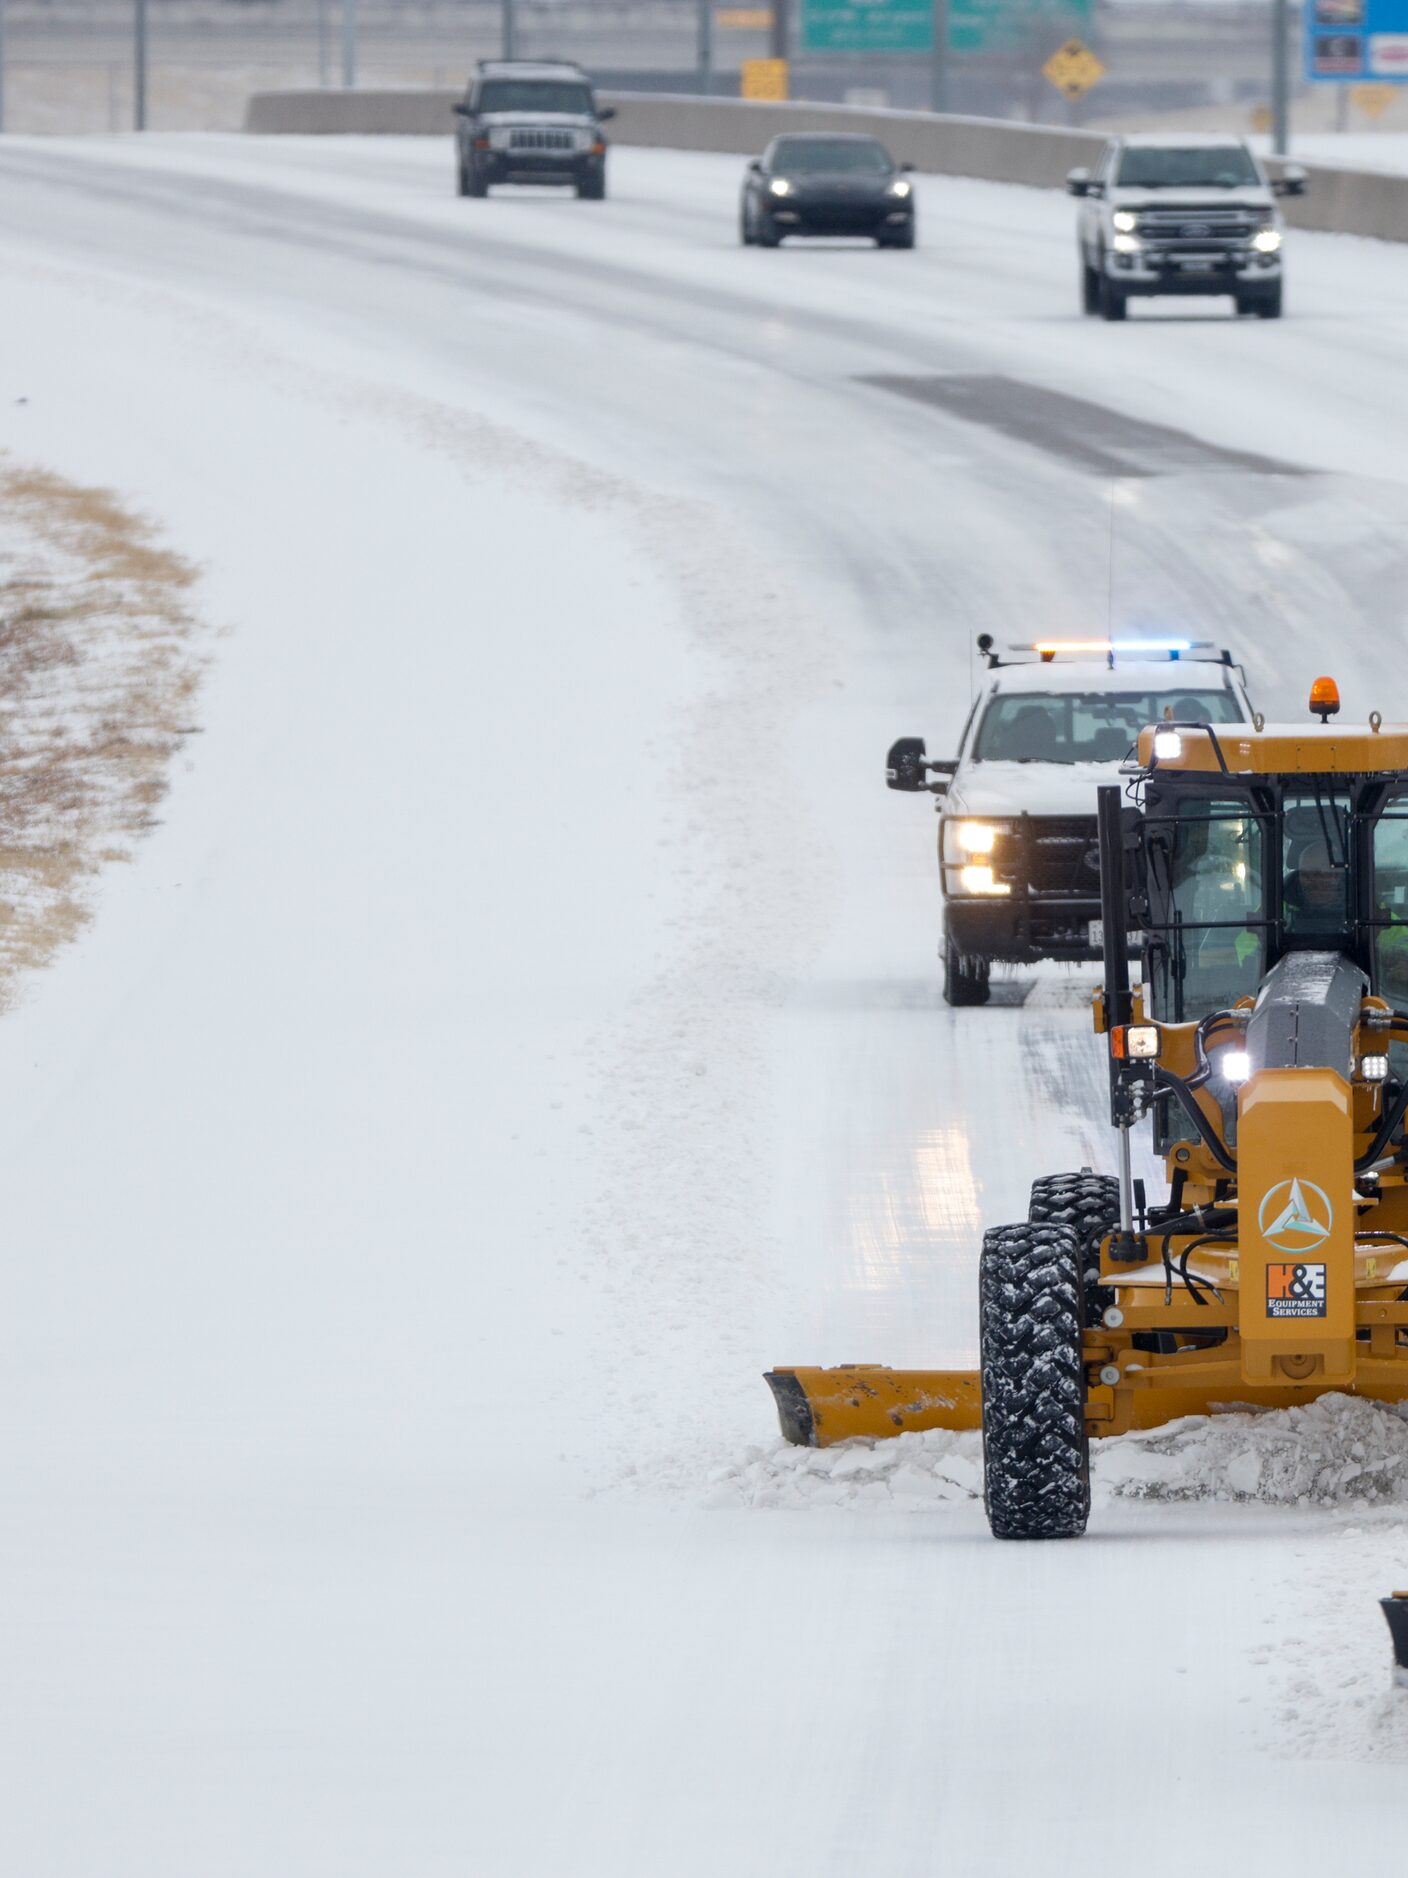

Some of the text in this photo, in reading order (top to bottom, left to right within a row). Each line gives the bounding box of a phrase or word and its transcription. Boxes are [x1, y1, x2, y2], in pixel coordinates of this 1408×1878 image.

[1268, 1265, 1325, 1298] H&E
[1268, 1299, 1324, 1308] EQUIPMENT
[1273, 1307, 1318, 1316] SERVICES
